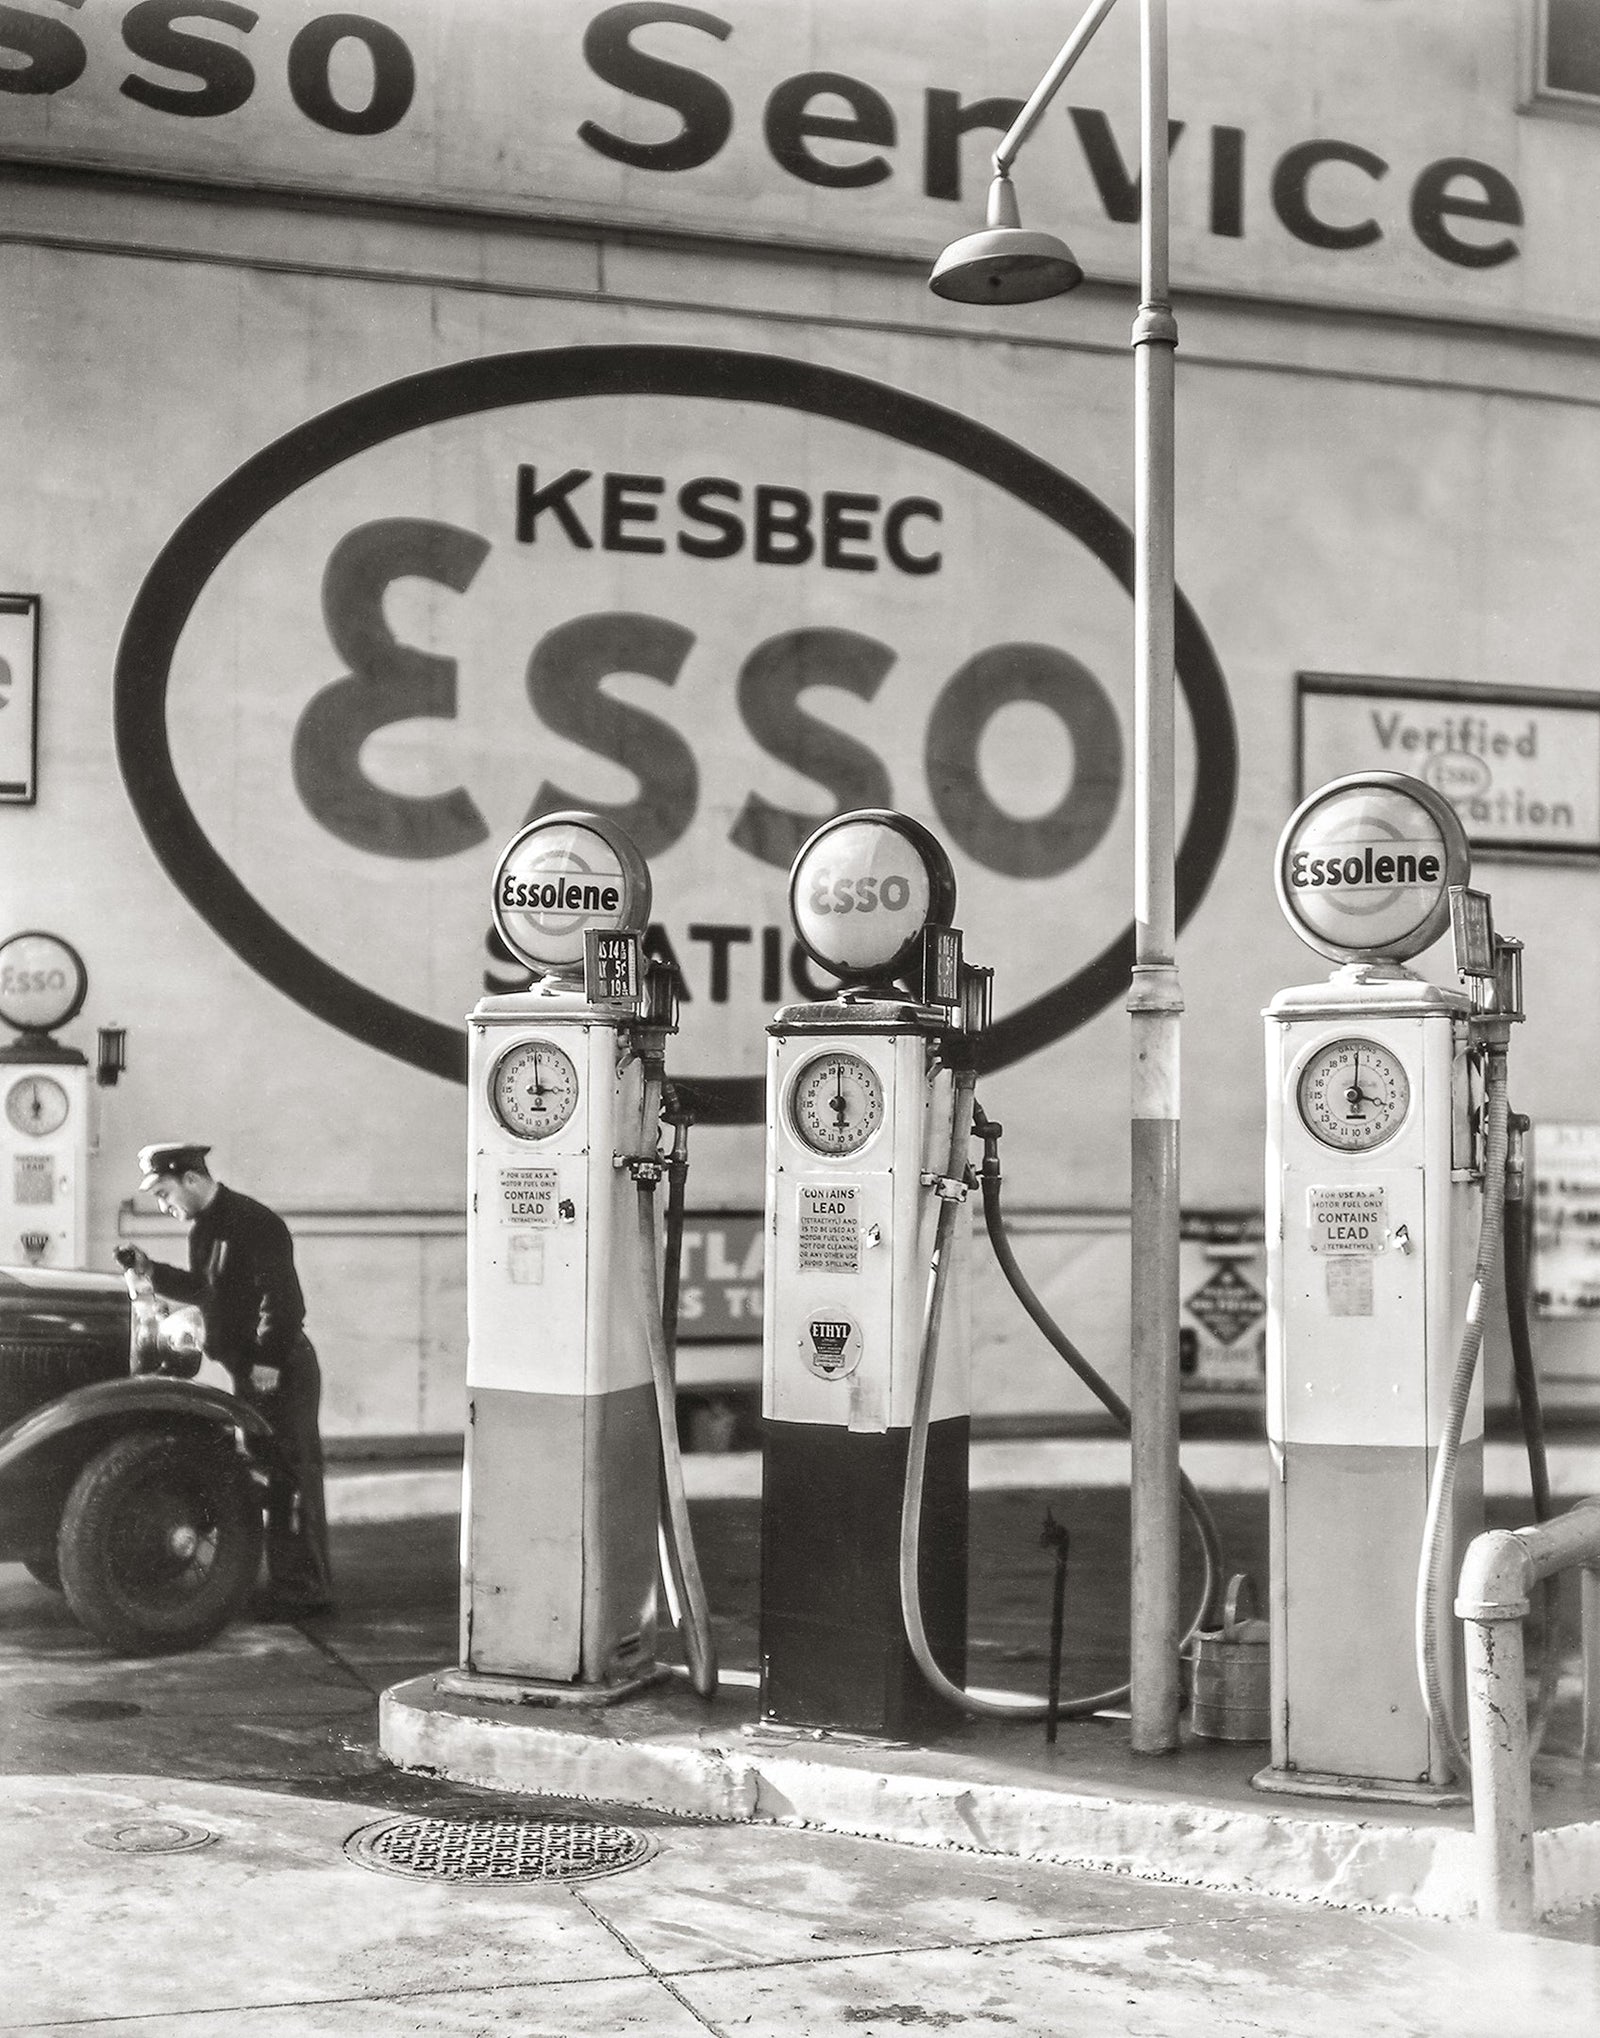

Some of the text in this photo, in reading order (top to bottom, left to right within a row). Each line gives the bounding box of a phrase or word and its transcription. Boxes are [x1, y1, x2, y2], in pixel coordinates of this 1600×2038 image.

[577, 1, 1525, 269] Service
[514, 463, 943, 574] KESBEC
[1370, 709, 1538, 758] Verified
[1453, 788, 1573, 827] ation
[1291, 847, 1440, 887] Essolene
[503, 875, 619, 911] Essolene
[1339, 1045, 1376, 1054] GALONS
[1339, 1055, 1348, 1063] 19
[858, 1072, 863, 1080] 2
[1384, 1068, 1390, 1076] 3
[1389, 1102, 1395, 1110] 6
[808, 1111, 815, 1119] 14
[1329, 1122, 1337, 1130] 12
[1365, 1127, 1371, 1135] 9
[1352, 1129, 1361, 1137] 10
[838, 1135, 845, 1143] 10
[504, 1191, 551, 1200] CONTAINS
[805, 1189, 854, 1199] CONTAINS
[512, 1203, 544, 1214] LEAD
[813, 1202, 845, 1214] LEAD
[1318, 1213, 1378, 1223] CONTAINS
[1328, 1227, 1369, 1240] LEAD
[813, 1324, 848, 1338] ETHYL
